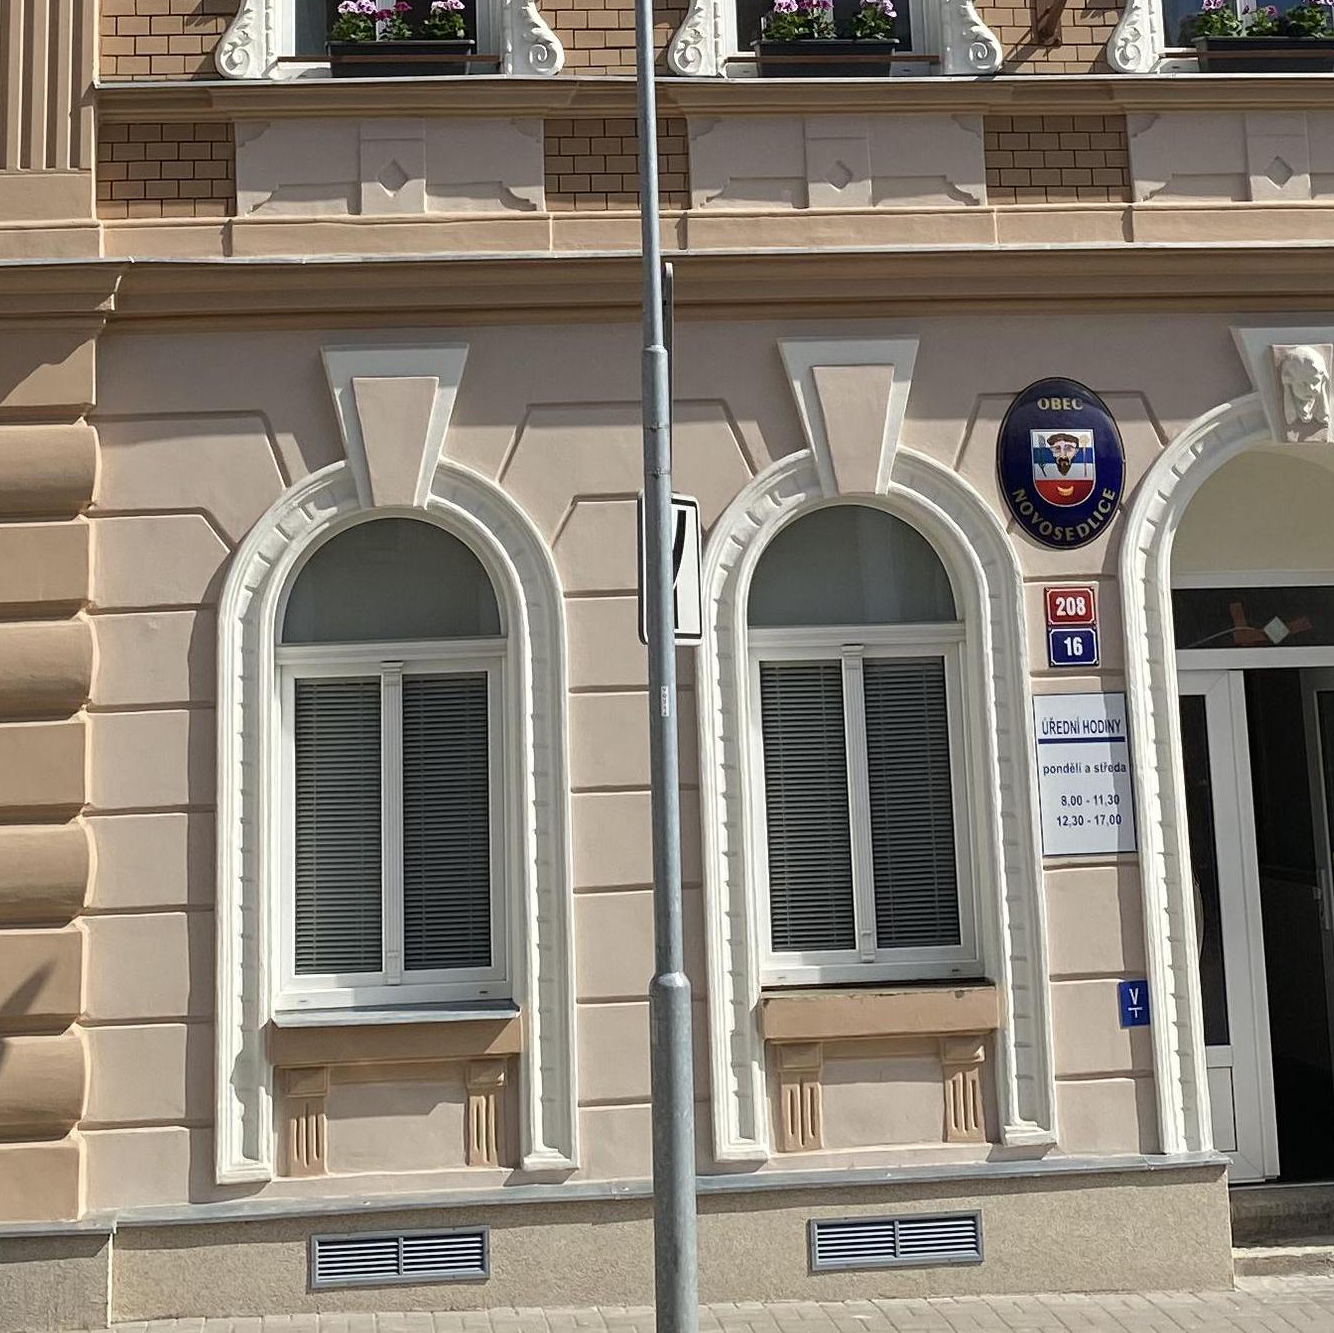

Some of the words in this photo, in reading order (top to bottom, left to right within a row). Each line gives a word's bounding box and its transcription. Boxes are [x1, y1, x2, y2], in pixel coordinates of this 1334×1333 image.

[1037, 397, 1084, 411] OBEC
[1010, 487, 1117, 542] NOVOSEDLICE
[1055, 596, 1087, 617] 208
[1064, 637, 1083, 657] 16
[1042, 717, 1081, 735] ÚŘEDNÍ
[1082, 718, 1122, 734] HODINY
[1084, 764, 1091, 774] a
[1093, 761, 1127, 774] středa
[1129, 987, 1139, 1005] V
